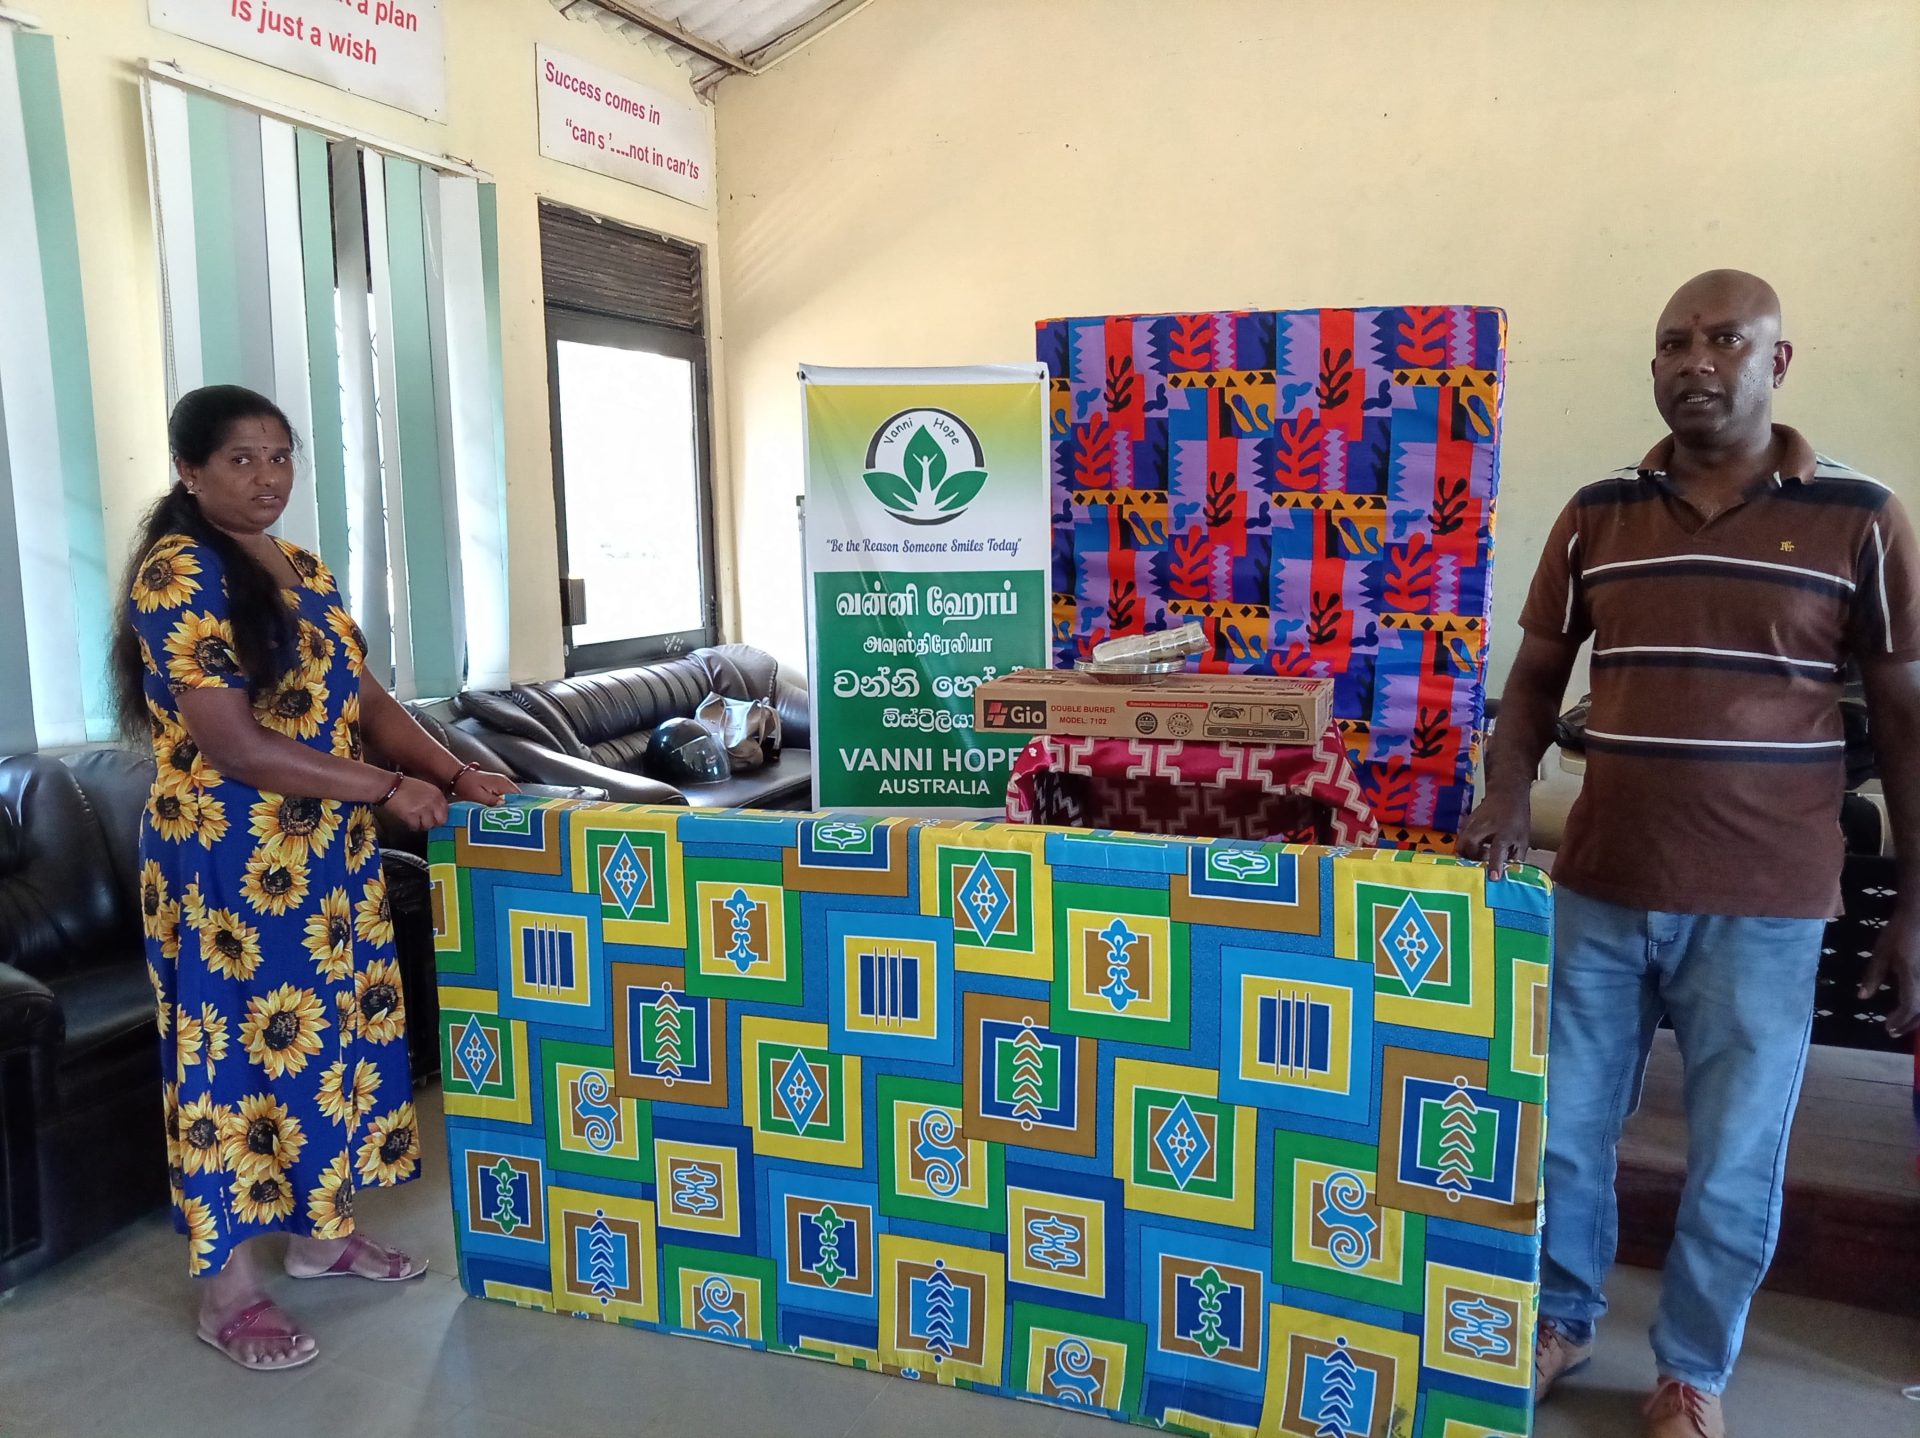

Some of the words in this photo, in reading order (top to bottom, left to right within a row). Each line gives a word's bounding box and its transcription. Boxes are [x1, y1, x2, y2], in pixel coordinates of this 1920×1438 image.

[375, 0, 417, 32] plan
[257, 2, 304, 41] just
[310, 26, 321, 47] a
[328, 32, 377, 65] wish
[545, 61, 601, 102] Success
[605, 91, 645, 120] comes
[648, 104, 660, 125] in
[652, 148, 663, 168] in
[666, 156, 699, 180] can’ts
[884, 417, 913, 445] Vanni
[933, 417, 960, 446] Hope
[845, 539, 861, 553] the
[862, 538, 900, 554] Reason
[902, 539, 948, 554] Someone
[950, 538, 984, 553] Smiles
[836, 580, 919, 617] வன்னி
[926, 579, 1018, 626] ஹோப்
[863, 630, 993, 658] அவுஸ்திரேலியா
[833, 665, 921, 699] වන්නි
[1010, 705, 1045, 724] Gio
[1050, 705, 1082, 714] DOUBLE
[1083, 705, 1116, 714] BURNER
[839, 747, 933, 773] VANNI
[878, 778, 991, 796] AUSTRALIA
